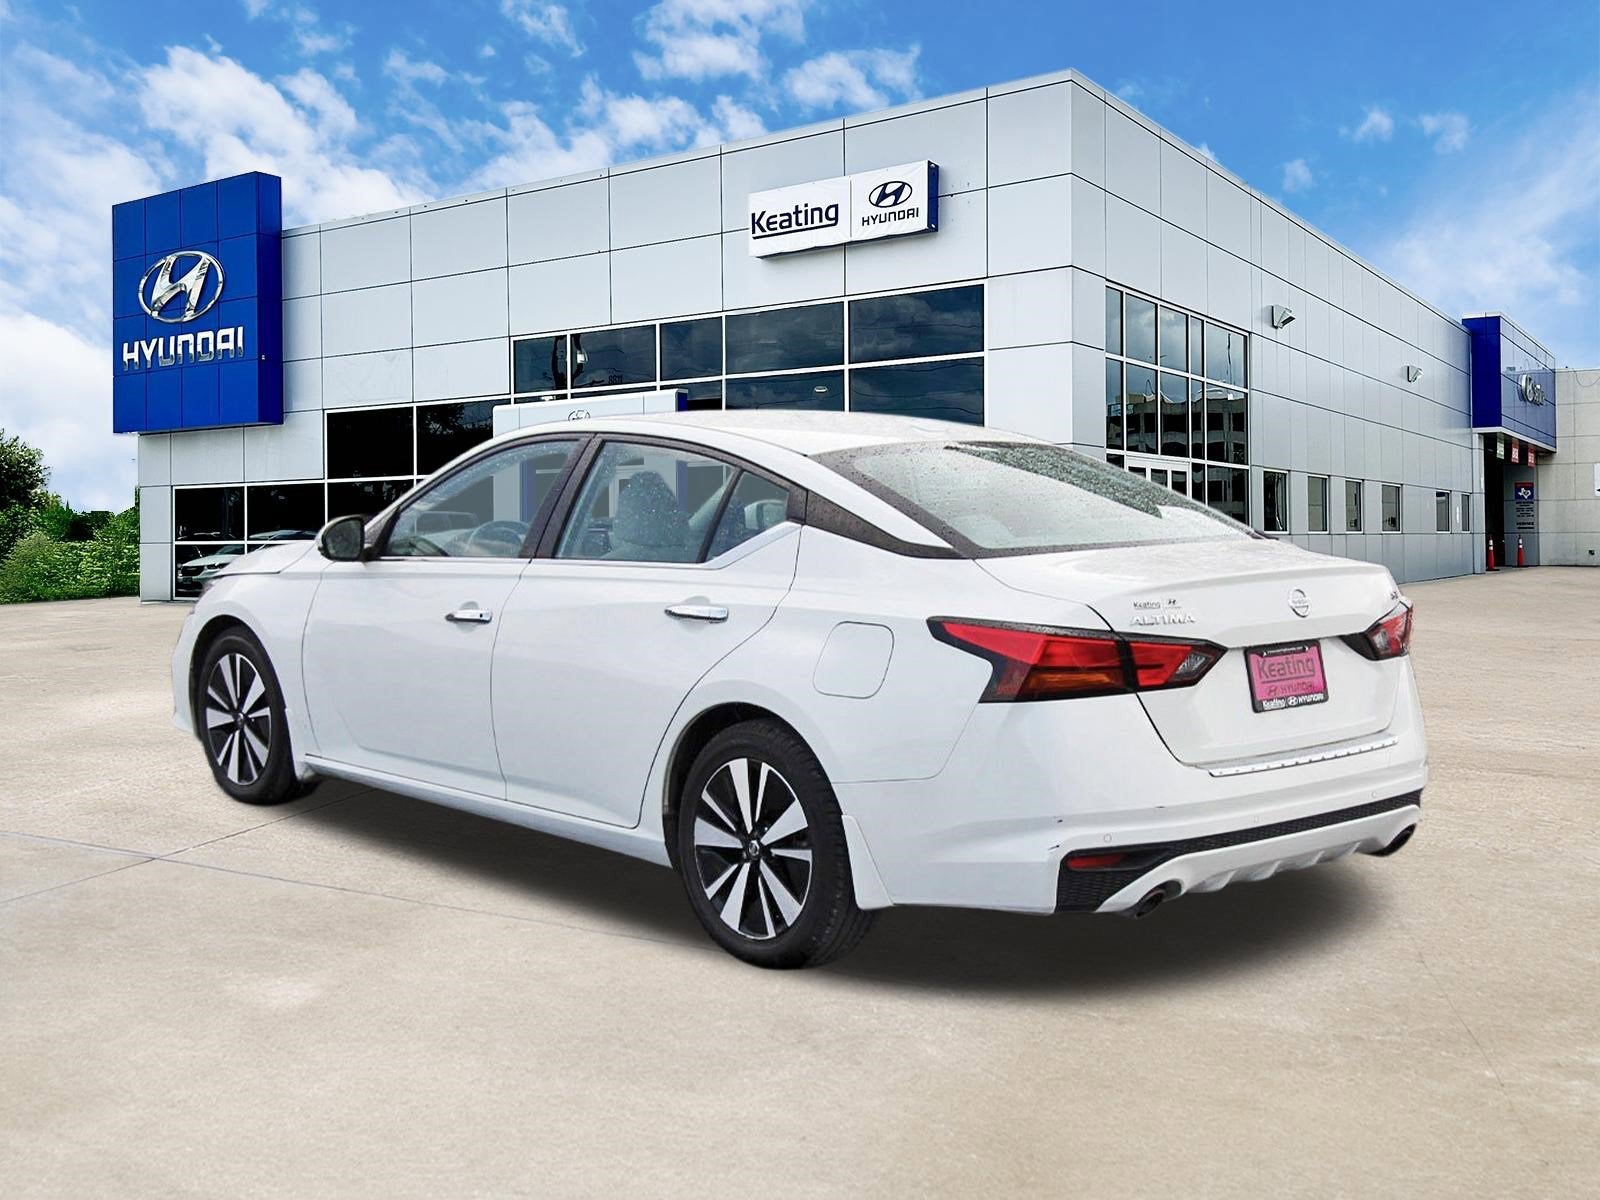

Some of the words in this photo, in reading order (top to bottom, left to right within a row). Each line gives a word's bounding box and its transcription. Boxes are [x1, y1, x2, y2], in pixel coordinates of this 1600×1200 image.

[751, 203, 839, 239] Keating
[861, 207, 919, 227] HYUNDAI
[122, 326, 244, 371] HYUNDAI
[1130, 613, 1196, 626] ALTIMA
[1257, 656, 1316, 682] Keating
